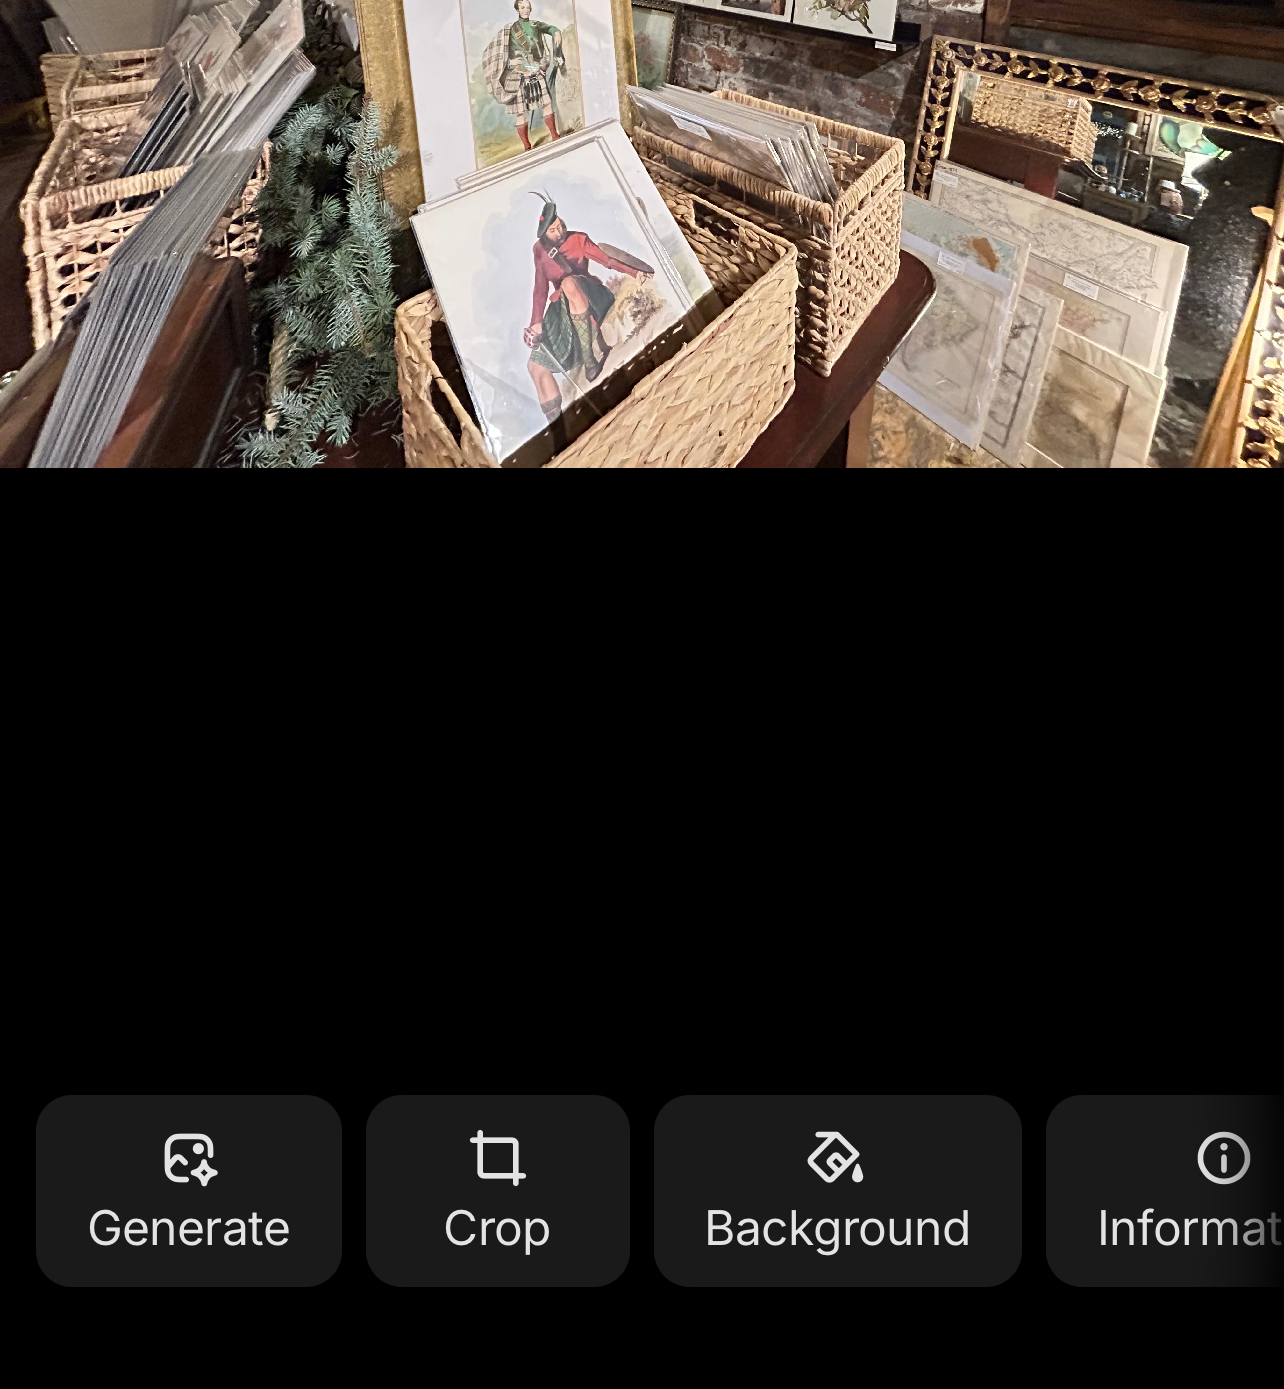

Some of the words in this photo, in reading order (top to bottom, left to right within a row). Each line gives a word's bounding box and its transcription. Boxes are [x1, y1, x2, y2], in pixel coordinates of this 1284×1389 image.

[89, 1208, 290, 1247] Generate
[445, 1208, 550, 1256] Crop
[707, 1208, 969, 1257] Background
